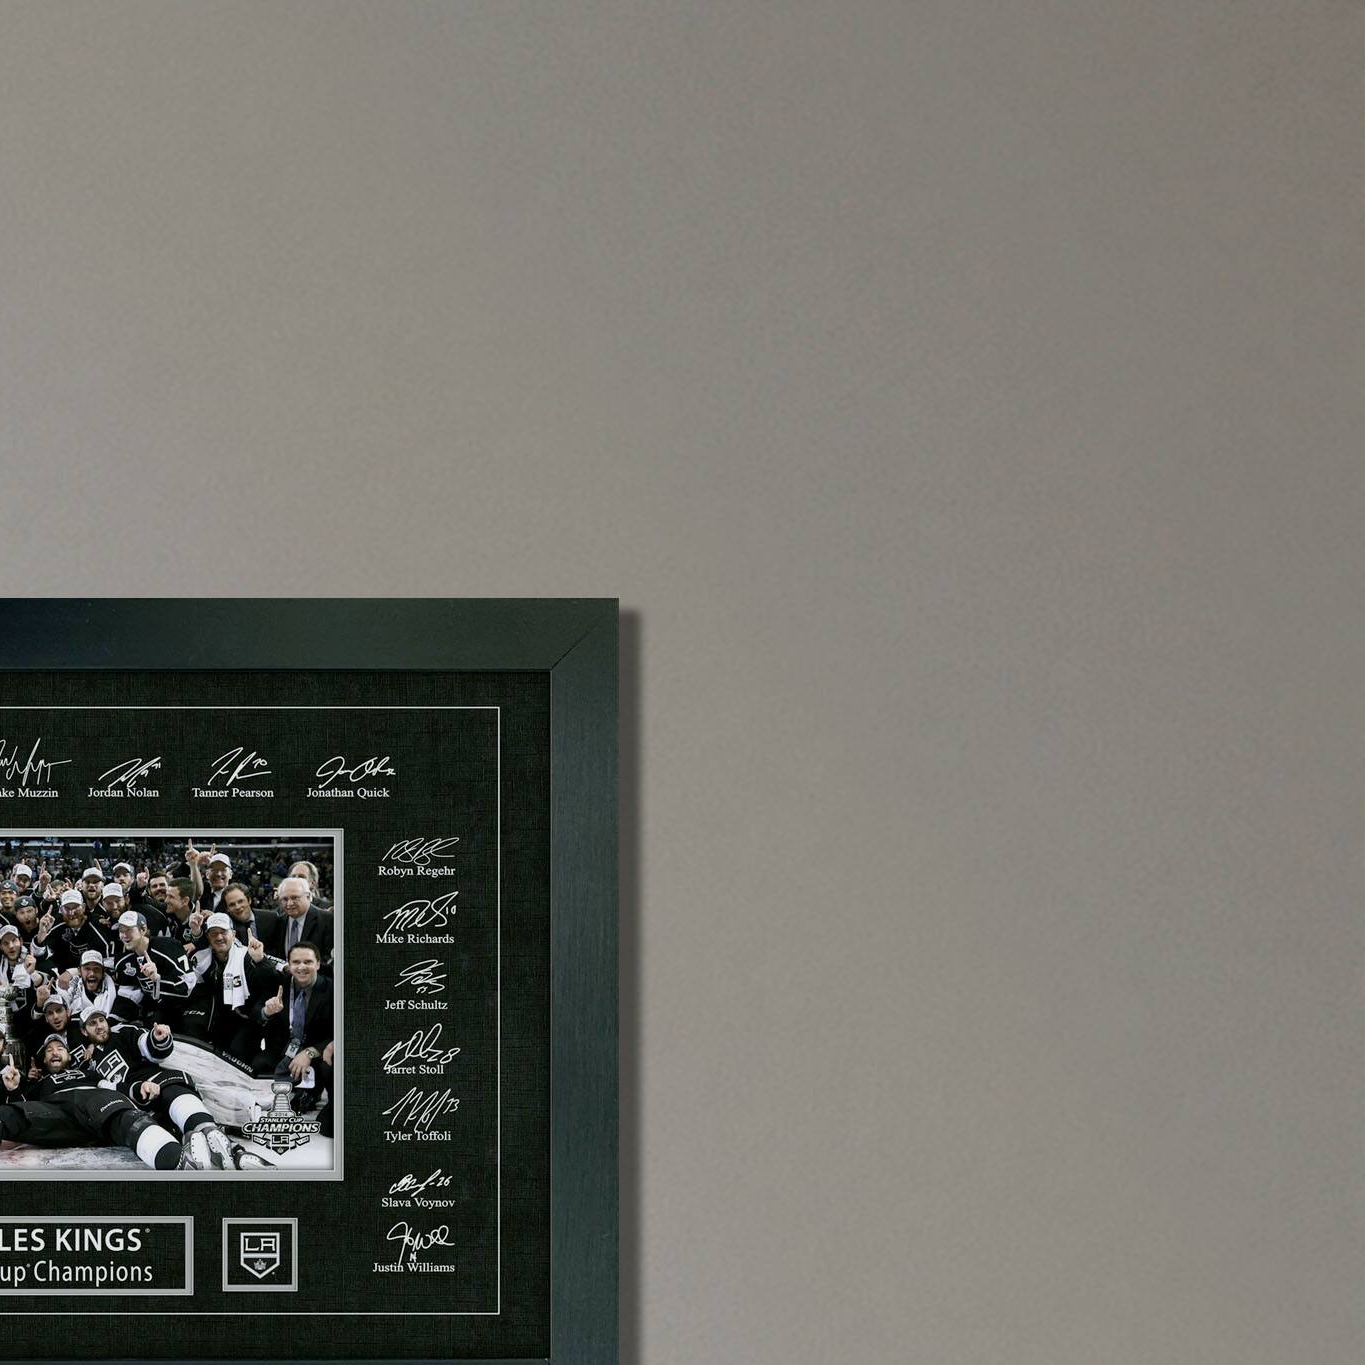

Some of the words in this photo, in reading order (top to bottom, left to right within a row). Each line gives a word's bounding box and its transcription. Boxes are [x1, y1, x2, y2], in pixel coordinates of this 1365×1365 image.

[18, 788, 58, 797] Muzzin
[88, 788, 122, 797] Jordan
[127, 787, 159, 797] Nolan
[192, 788, 229, 797] Tanner
[232, 788, 274, 797] Pearson
[307, 788, 352, 797] Jonathan
[357, 788, 389, 799] Quick
[379, 866, 413, 877] Robyn
[417, 866, 455, 878] Regehr
[376, 934, 404, 943] Mike
[408, 934, 454, 943] Richards
[385, 1000, 405, 1009] Jeff
[408, 1000, 448, 1009] Schultz
[221, 1050, 254, 1073] VAUGHN
[386, 1065, 416, 1074] Jarret
[419, 1065, 444, 1074] Stoll
[243, 1123, 319, 1132] CHAMPIONS
[384, 1131, 412, 1143] Tyler
[415, 1131, 451, 1140] Toffoli
[382, 1198, 411, 1207] Slava
[414, 1198, 455, 1209] Voynov
[56, 1229, 142, 1251] KINGS
[373, 1263, 403, 1272] Justin
[407, 1263, 455, 1272] Williams
[34, 1260, 152, 1287] Champions
